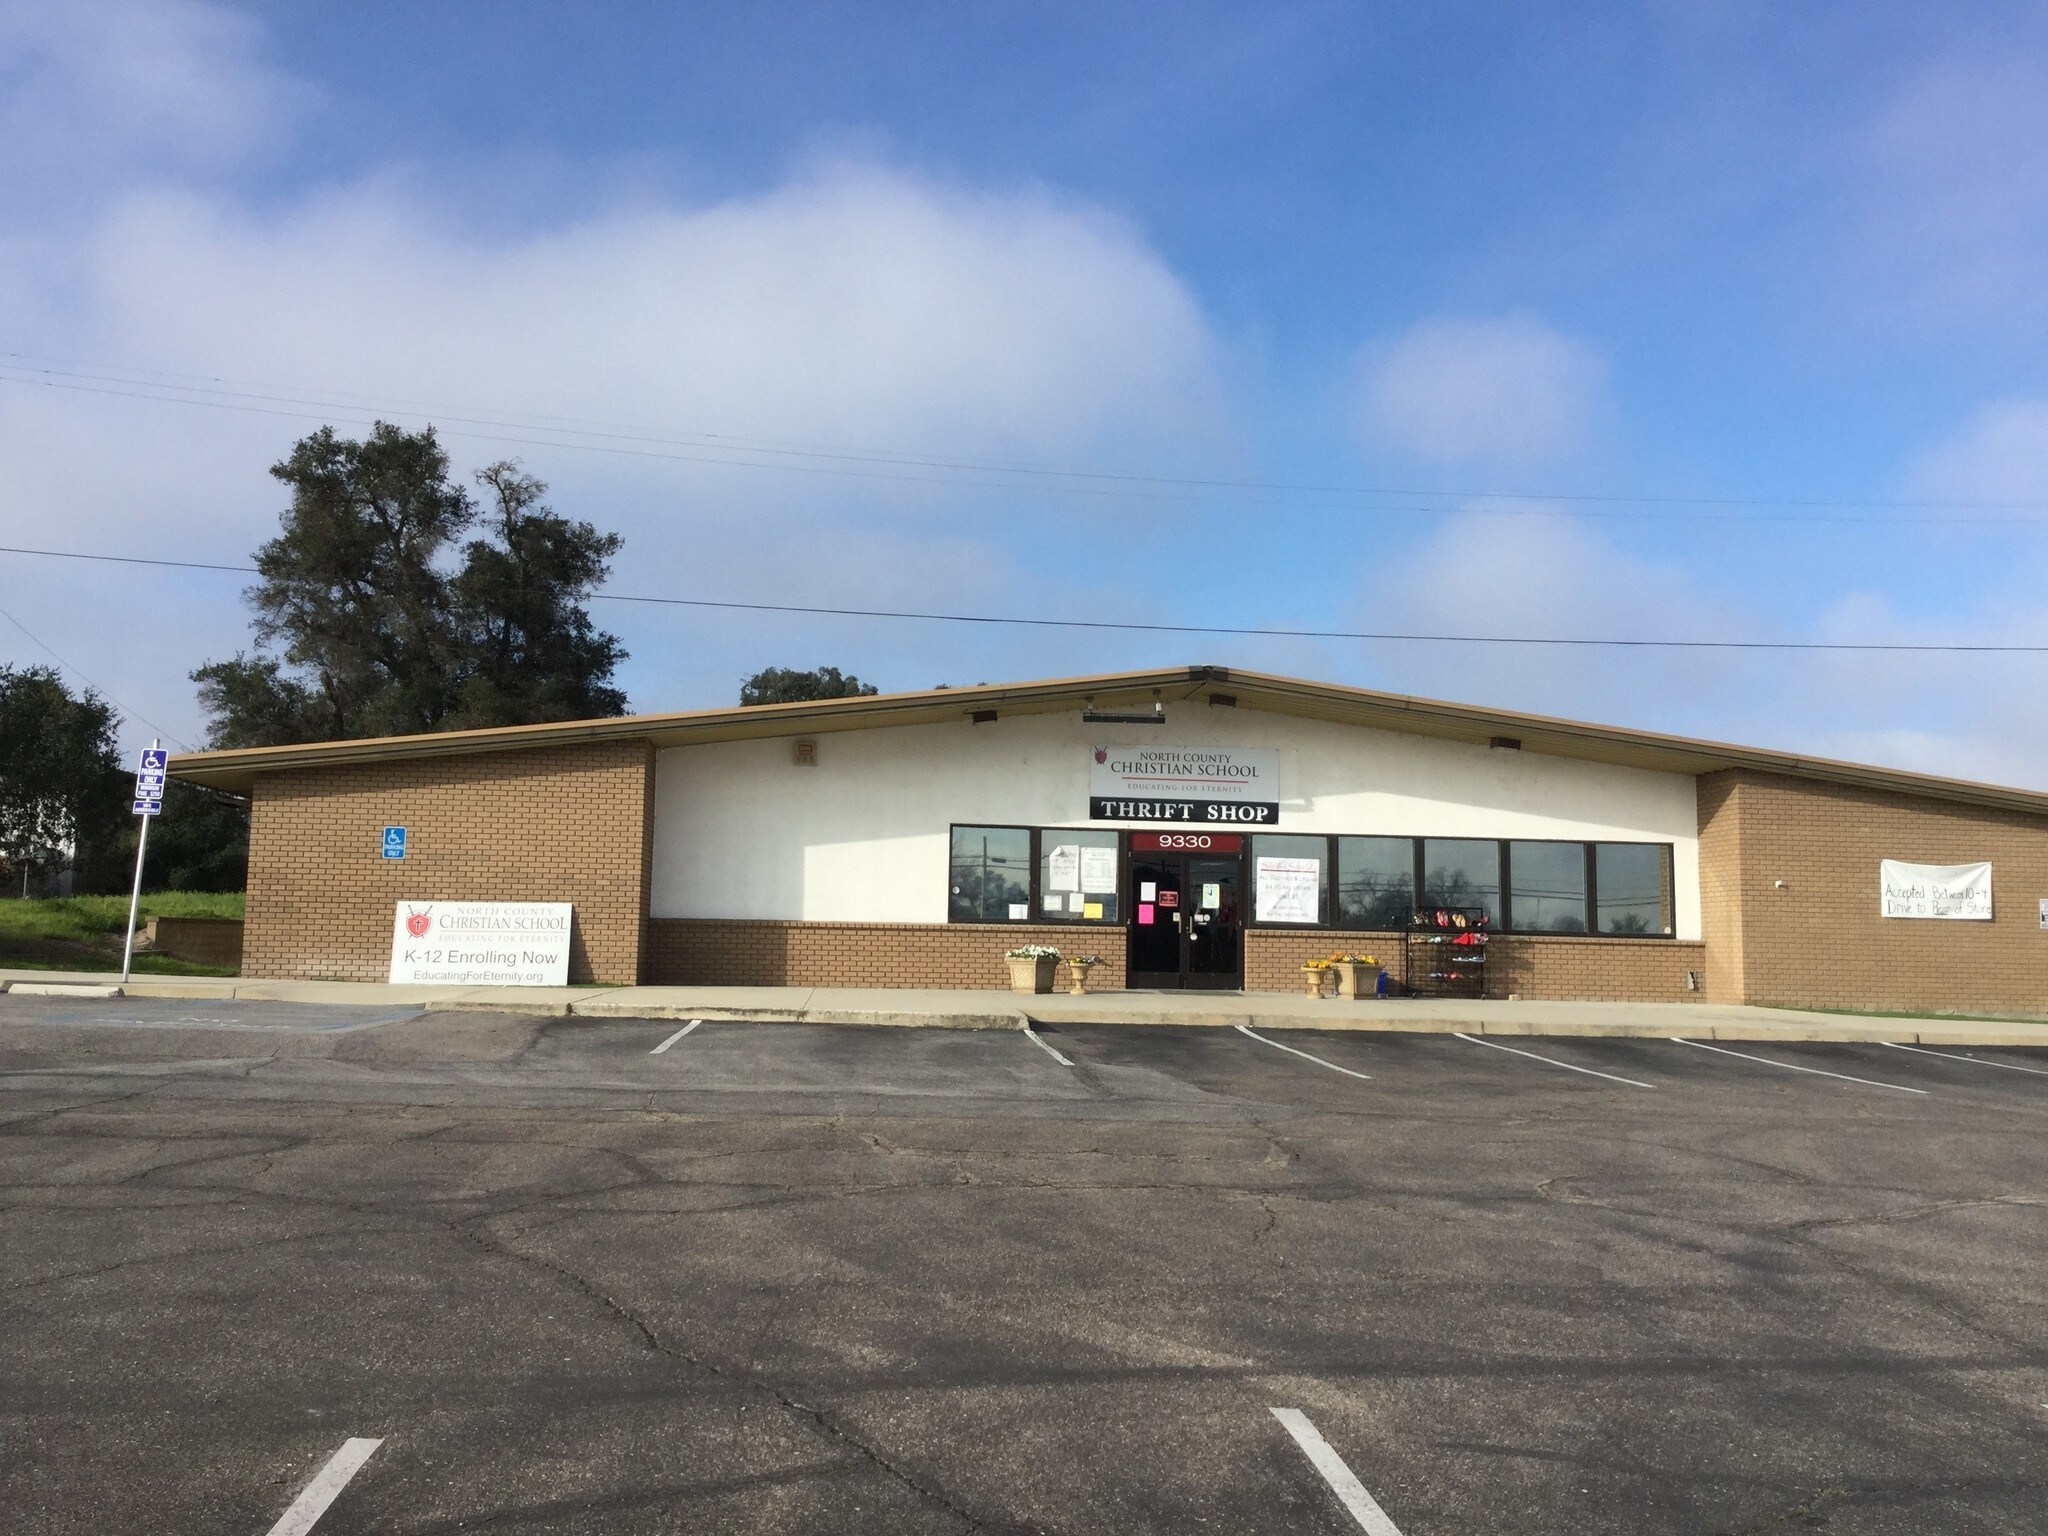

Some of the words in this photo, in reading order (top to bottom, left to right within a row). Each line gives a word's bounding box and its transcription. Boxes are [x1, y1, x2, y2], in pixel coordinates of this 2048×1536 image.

[1140, 752, 1180, 762] NORTH
[1183, 753, 1232, 763] COUNTY
[141, 768, 163, 776] PARKING
[1110, 761, 1193, 775] CHRISTIAN
[1197, 764, 1259, 778] SCHOOL
[1128, 783, 1177, 791] EDUCATING
[1202, 785, 1243, 793] ETERNITY
[1101, 801, 1194, 819] THRIFT
[1207, 804, 1269, 821] SHOP
[1159, 834, 1211, 848] 9330
[1885, 884, 1925, 901] Accepted
[457, 907, 499, 916] NORTH
[504, 907, 554, 916] COUNTY
[1887, 900, 1912, 914] Drive
[1917, 901, 1926, 914] to
[1954, 901, 1963, 913] of
[1967, 901, 1992, 914] Store
[439, 914, 512, 929] CHRISTIAN
[514, 916, 568, 930] SCHOOL
[439, 934, 494, 942] EDUCATING
[499, 935, 516, 943] FOR
[520, 935, 564, 943] ETERNITY
[404, 950, 442, 964] K-12
[448, 950, 517, 967] Enrolling
[522, 951, 558, 964] Now
[413, 970, 544, 983] EducatingForEternity.org
